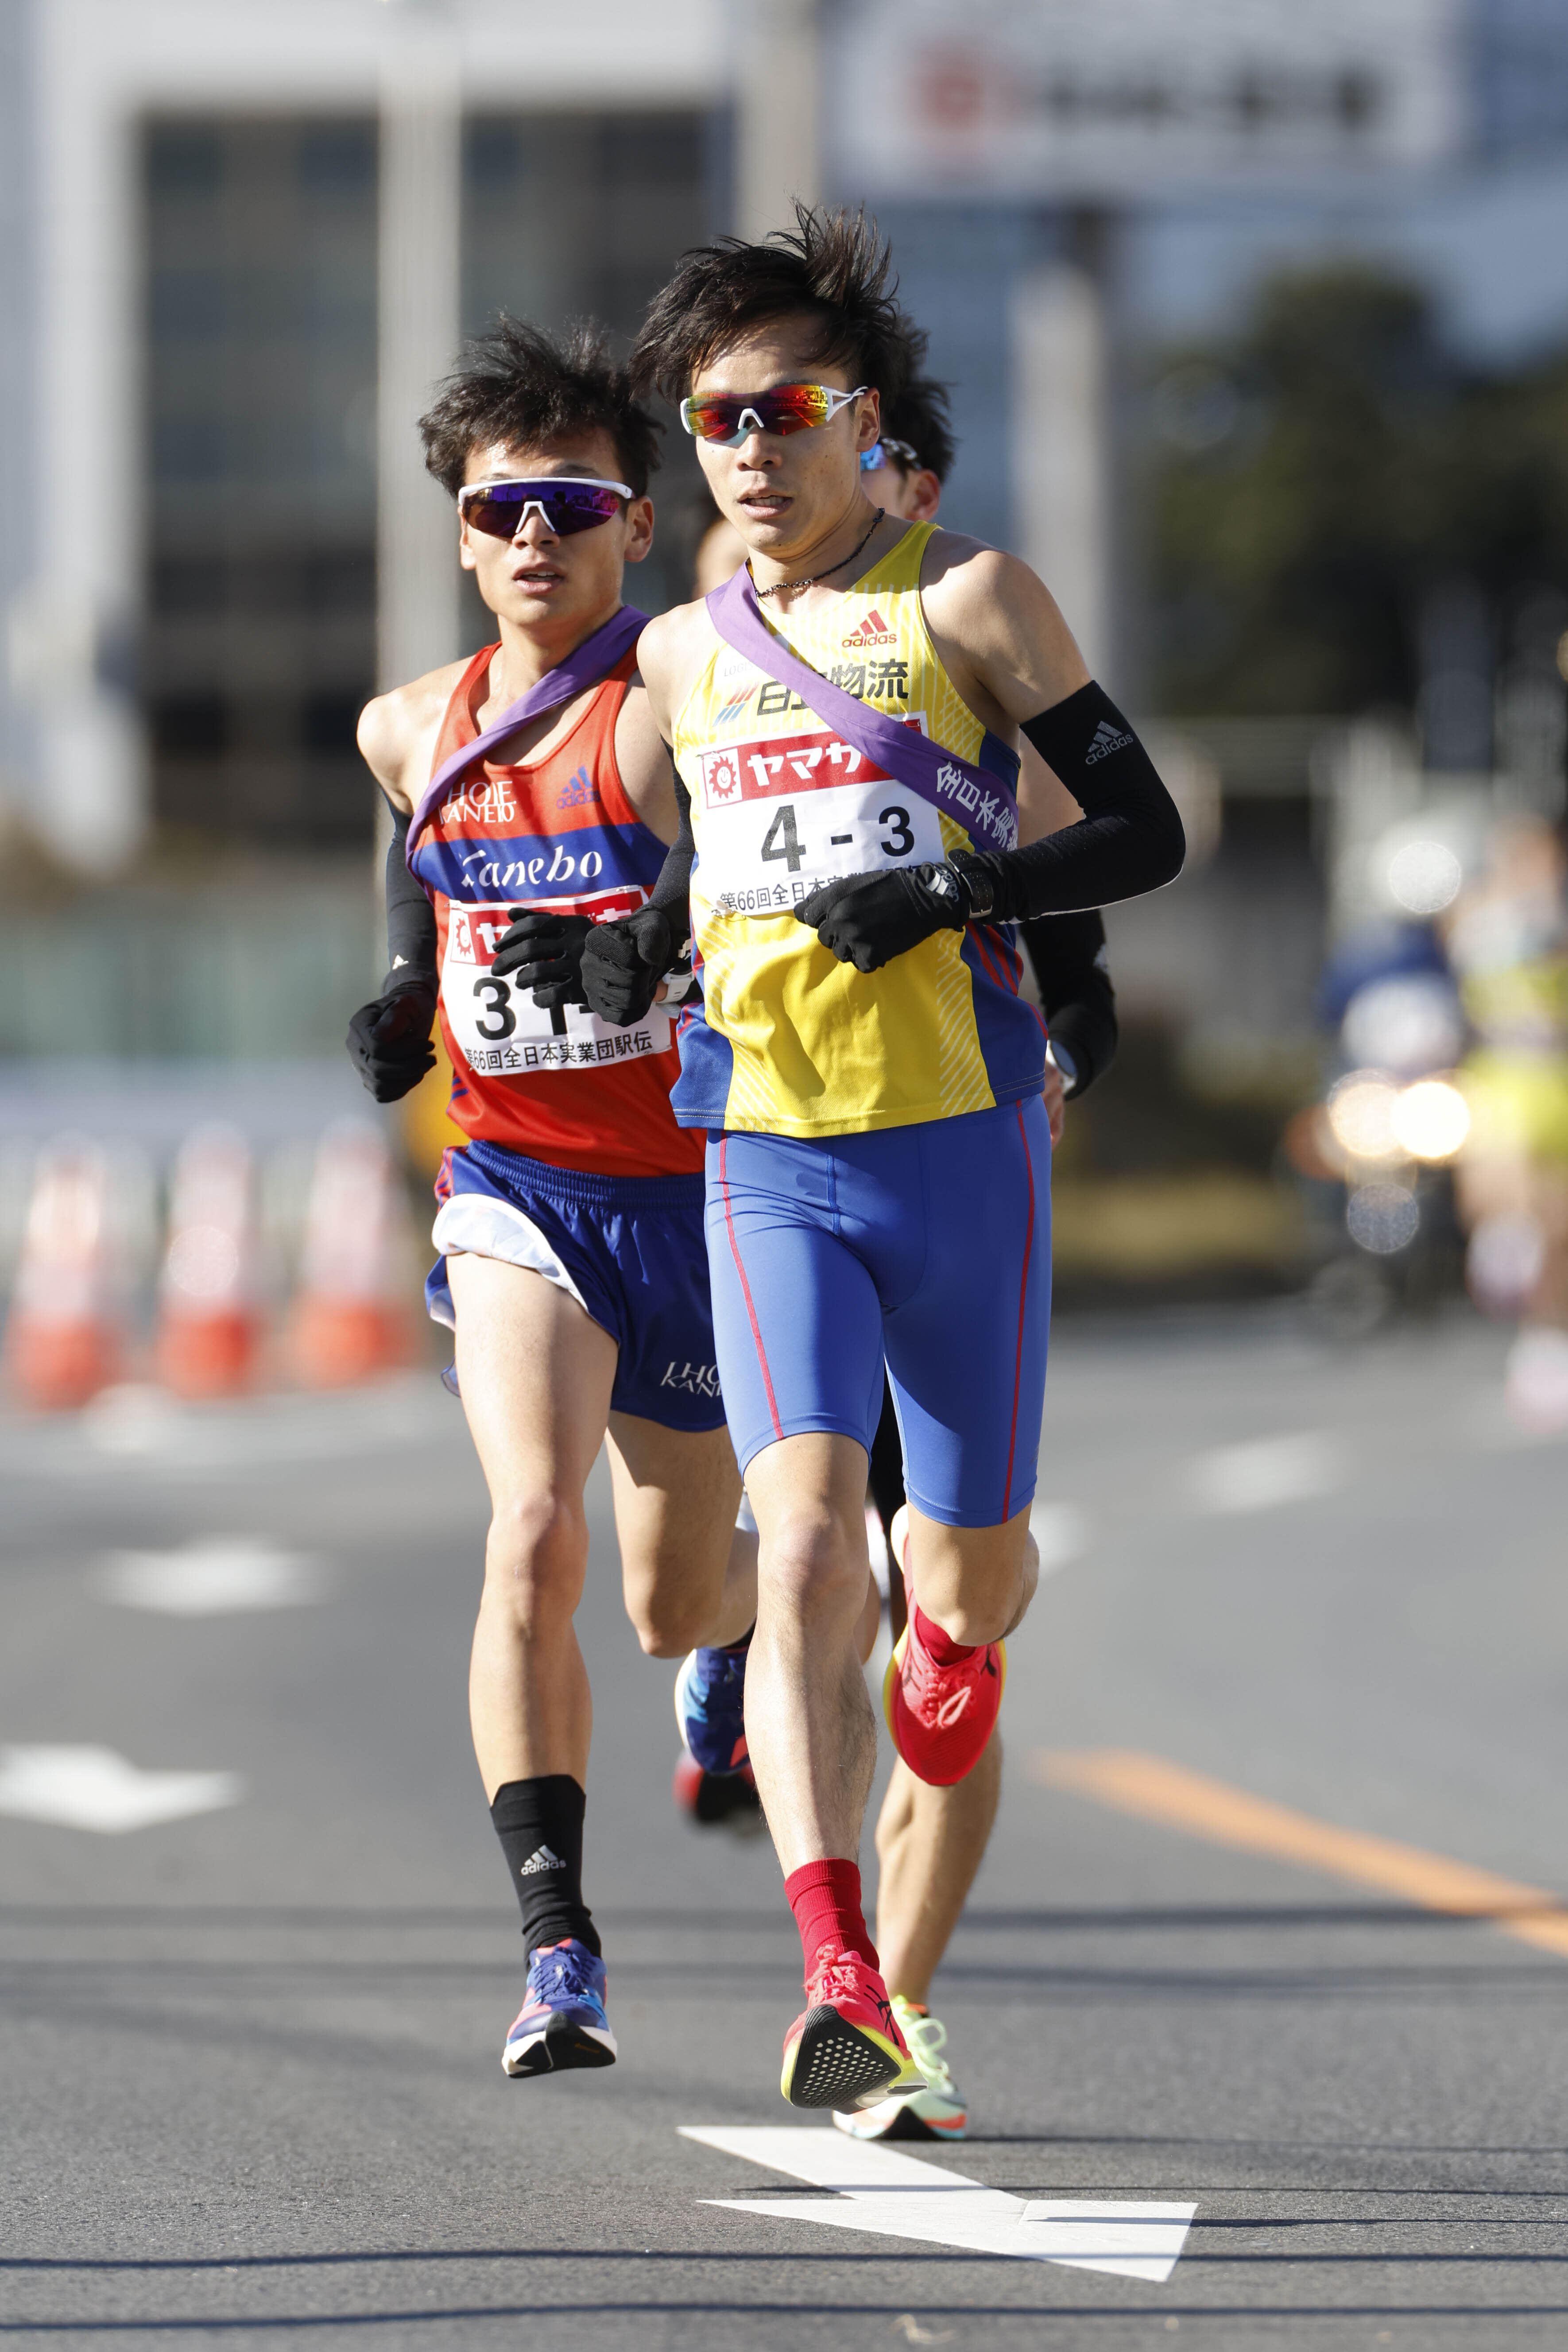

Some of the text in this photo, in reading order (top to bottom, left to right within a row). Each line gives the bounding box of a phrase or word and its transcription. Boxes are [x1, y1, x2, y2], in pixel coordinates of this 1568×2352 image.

[842, 633, 897, 648] adidas
[1085, 734, 1134, 765] adidas
[557, 790, 601, 810] adidas
[521, 1860, 566, 1875] adidas
